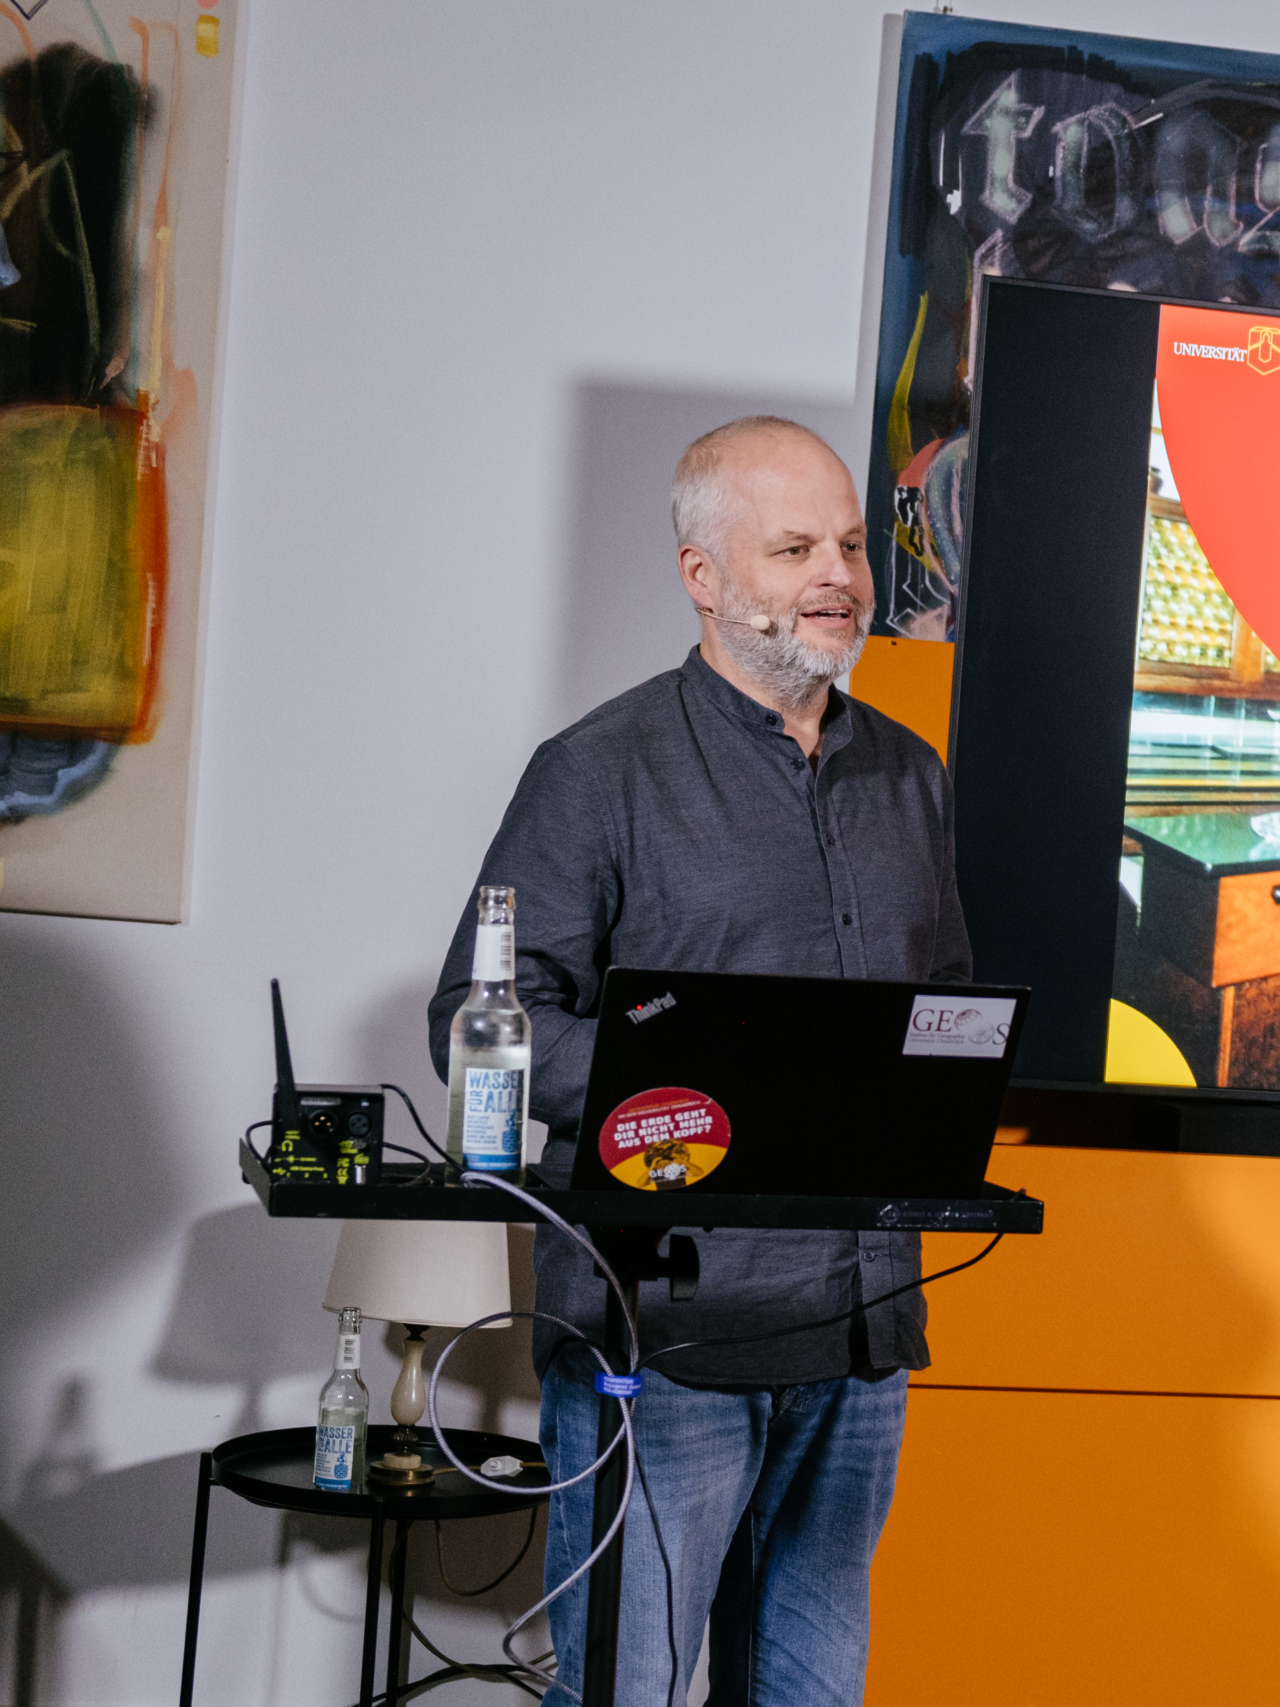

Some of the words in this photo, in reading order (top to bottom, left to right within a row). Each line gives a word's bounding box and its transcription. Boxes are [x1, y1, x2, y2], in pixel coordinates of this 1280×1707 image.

[1173, 341, 1247, 362] UNIVERSITÄT
[626, 991, 677, 1025] ThinkPad
[469, 1070, 523, 1090] WASSE
[614, 1130, 636, 1141] DIR
[638, 1122, 675, 1137] NICHT
[679, 1116, 713, 1129] MEHR
[617, 1121, 637, 1132] DIE
[640, 1115, 671, 1128] ERDE
[674, 1108, 706, 1121] GEHT
[618, 1137, 641, 1149] AUS
[644, 1132, 670, 1144] DEM
[673, 1125, 711, 1139] KOPF?
[319, 1426, 353, 1439] WASSER
[324, 1439, 352, 1454] ALLE
